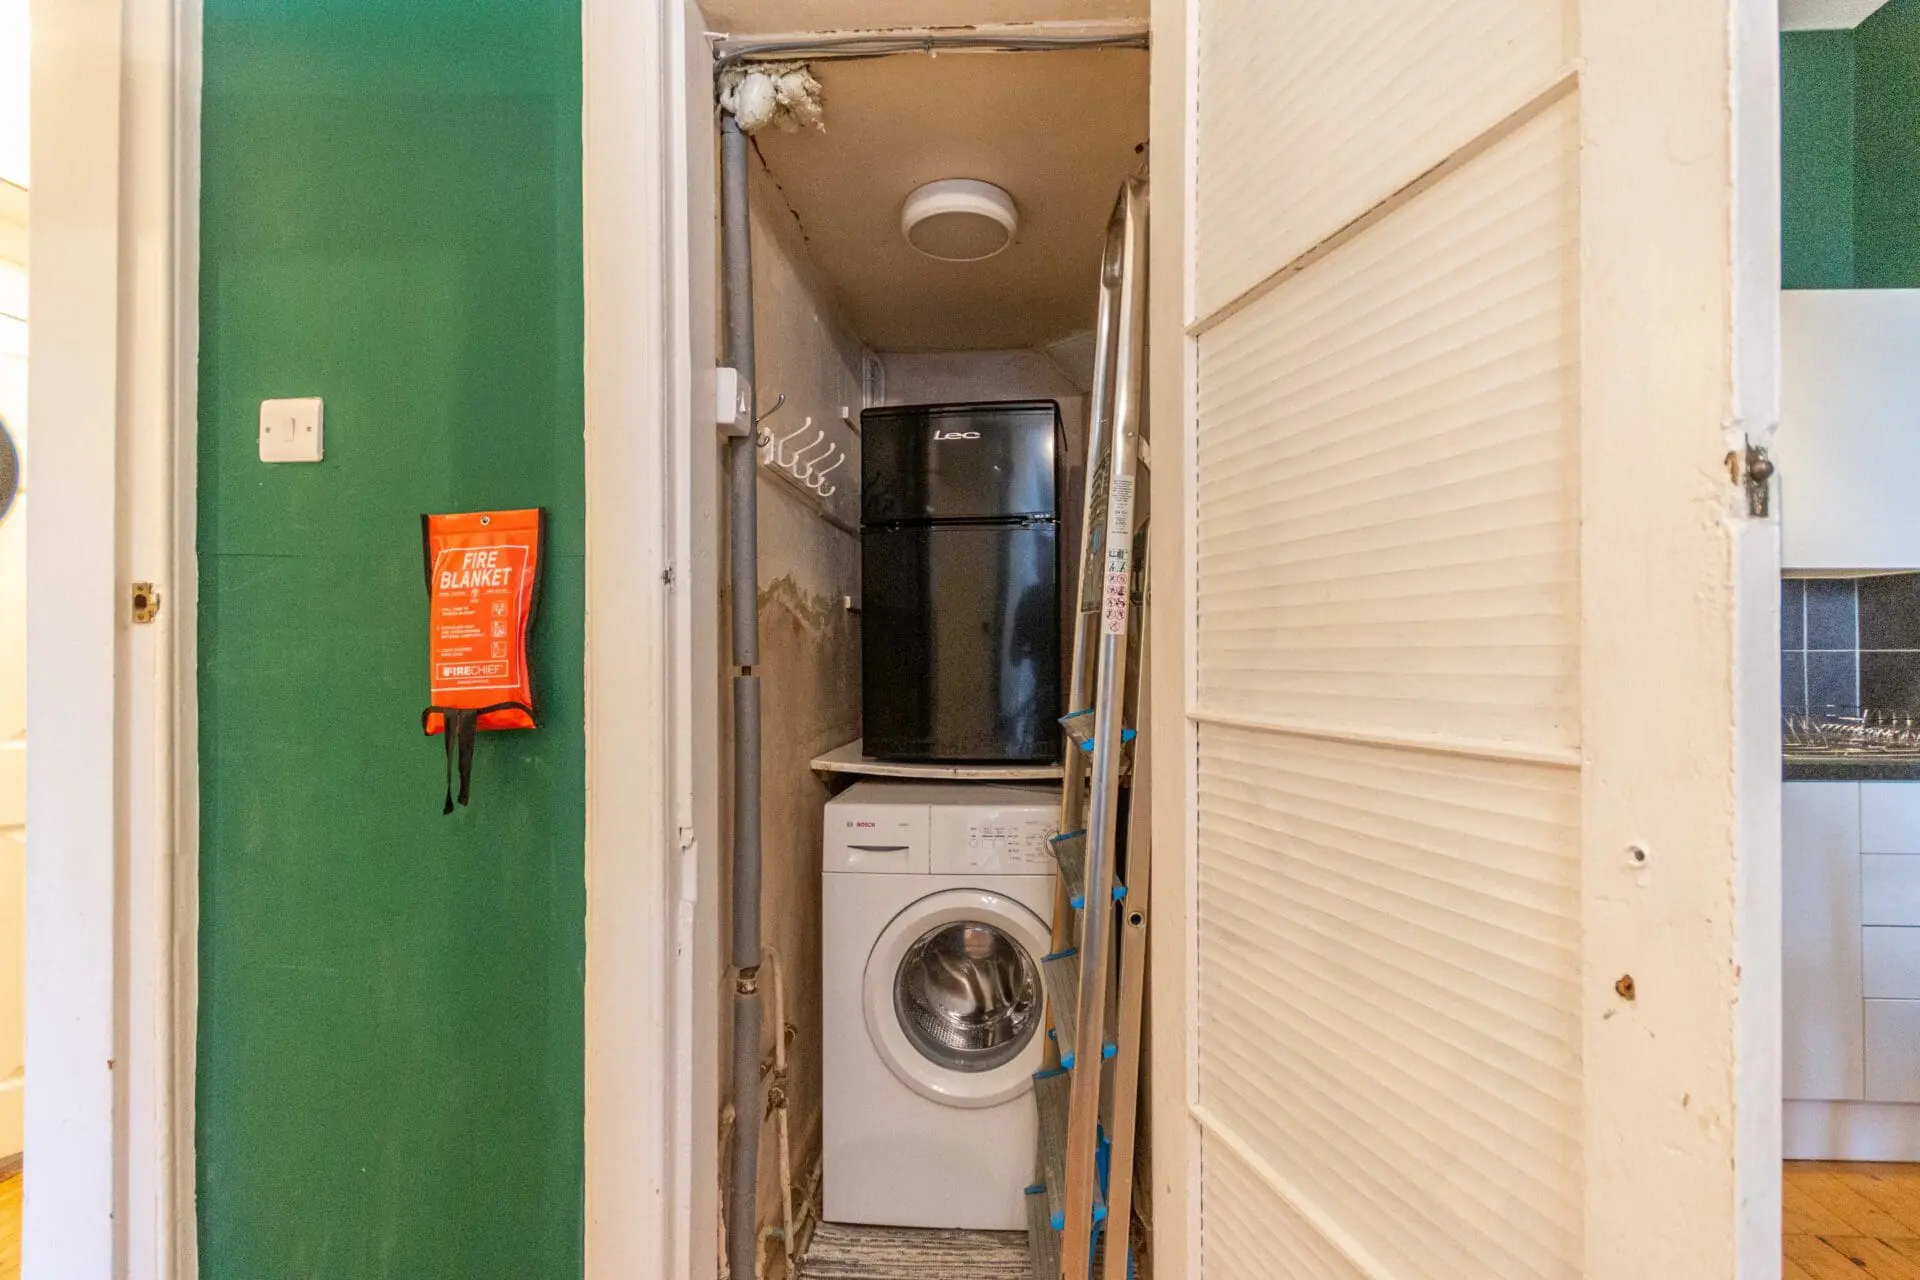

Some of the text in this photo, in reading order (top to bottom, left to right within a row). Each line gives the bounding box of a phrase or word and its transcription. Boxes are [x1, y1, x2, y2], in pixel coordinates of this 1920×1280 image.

[463, 551, 499, 570] FIRE
[440, 567, 513, 589] BLANKET
[448, 664, 502, 677] FIRECHIEF
